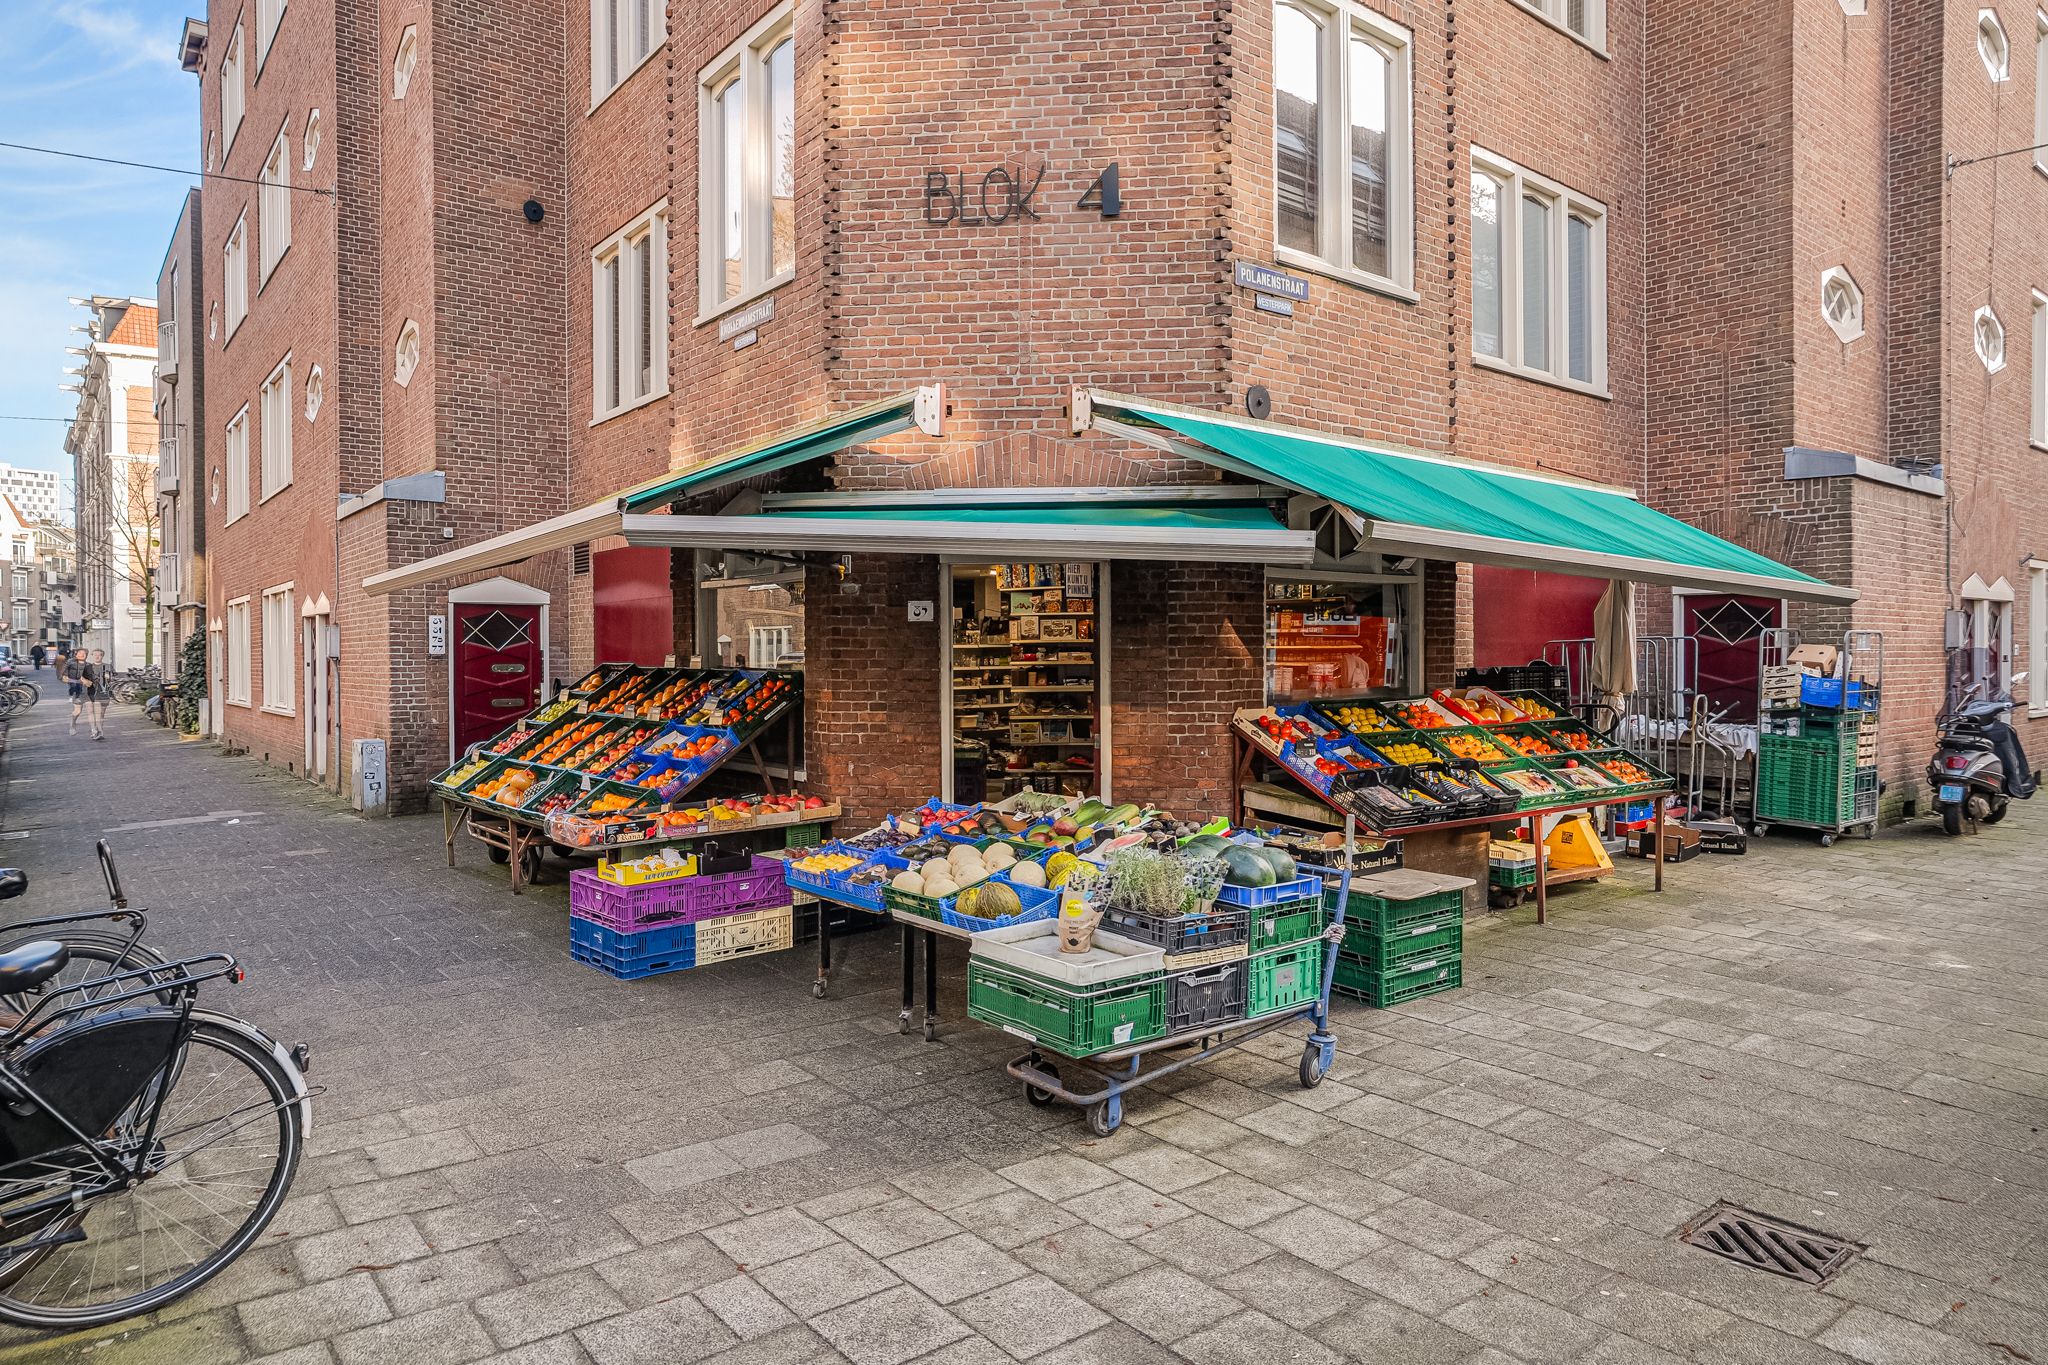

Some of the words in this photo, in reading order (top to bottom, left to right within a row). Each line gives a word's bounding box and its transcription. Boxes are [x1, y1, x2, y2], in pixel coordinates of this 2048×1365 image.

[927, 164, 1044, 224] BLOK
[1077, 162, 1123, 216] 4
[1241, 267, 1305, 296] POLANENSTRAAT
[1257, 297, 1292, 312] WESTERPARK
[1067, 564, 1081, 574] HIER
[1067, 584, 1089, 595] PINNEN
[1360, 857, 1381, 870] Natural
[1382, 855, 1397, 866] Hand
